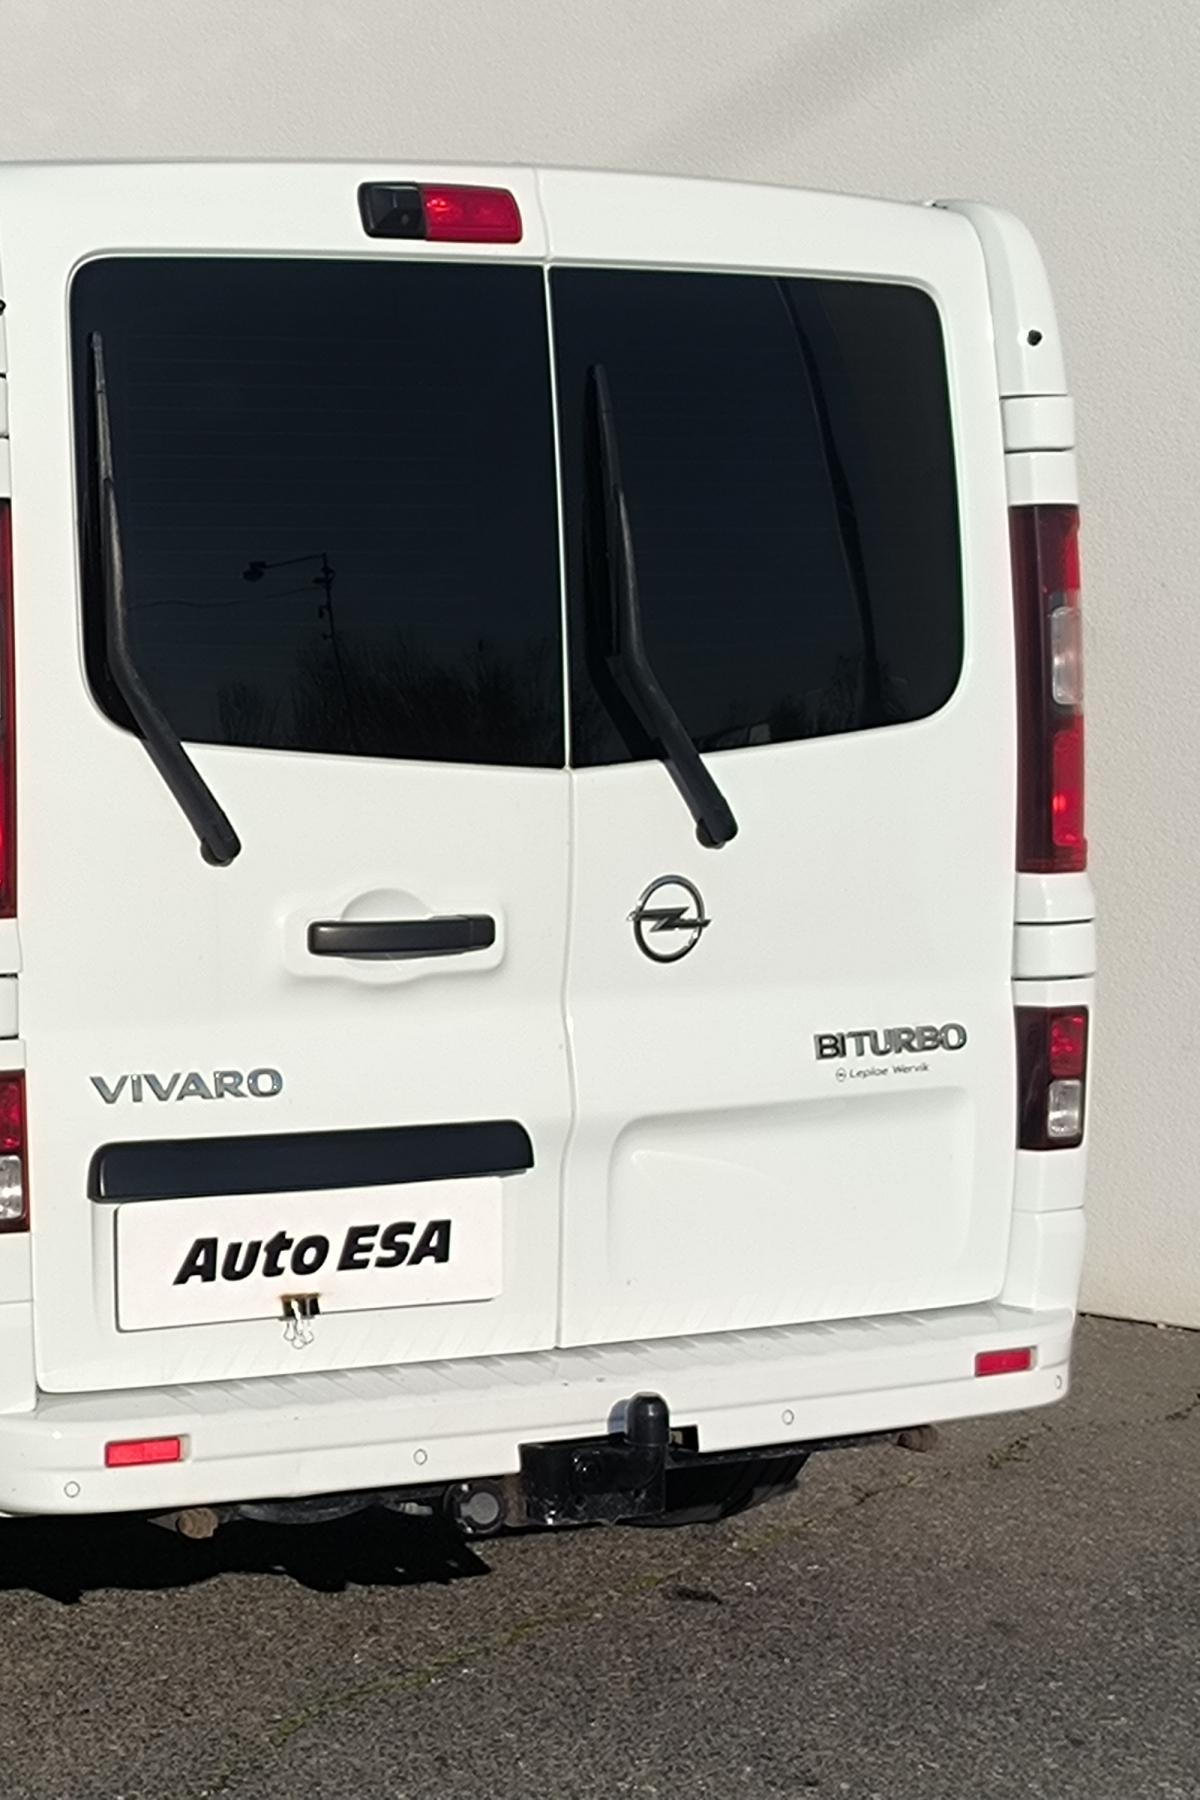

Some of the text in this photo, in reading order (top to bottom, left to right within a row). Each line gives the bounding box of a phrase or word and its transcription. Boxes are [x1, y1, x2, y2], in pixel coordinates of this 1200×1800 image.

[813, 1023, 968, 1060] BITURBO
[90, 1068, 284, 1105] VIVARO
[173, 1219, 452, 1286] Auto ESA
